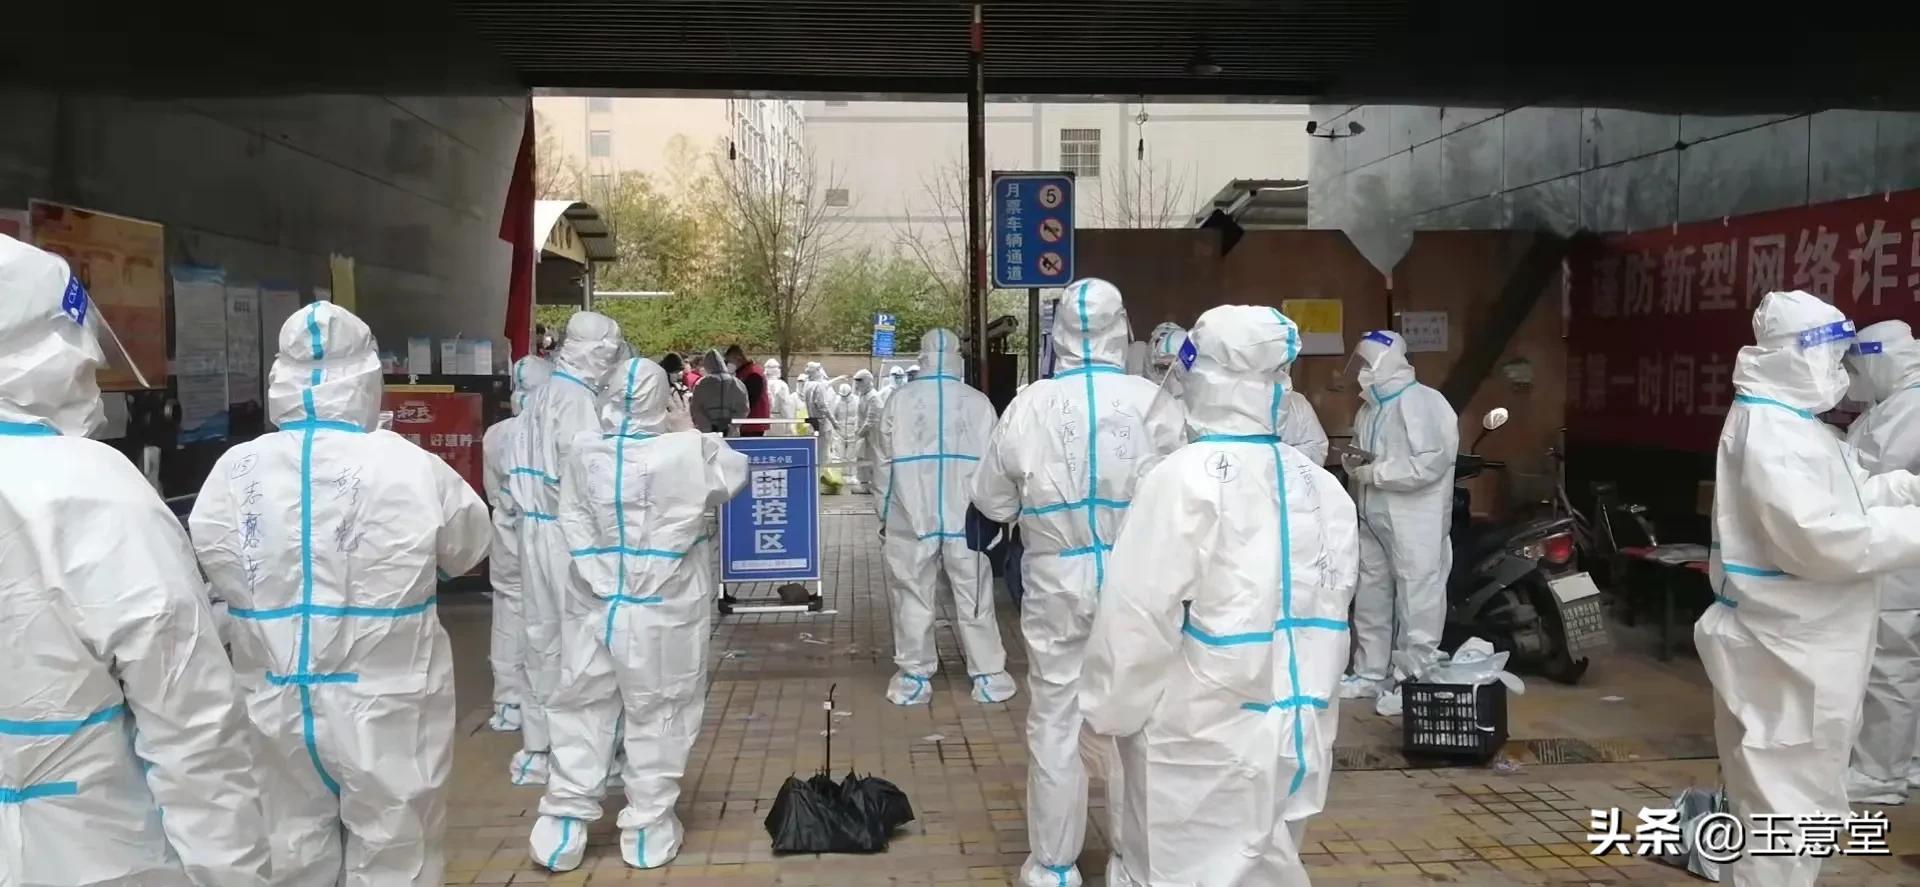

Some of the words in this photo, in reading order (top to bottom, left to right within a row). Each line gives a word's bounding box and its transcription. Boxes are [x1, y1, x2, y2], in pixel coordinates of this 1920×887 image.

[1046, 188, 1057, 204] 5
[1006, 183, 1022, 281] 月票车辆通道
[748, 455, 793, 465] 光上东小区
[1215, 453, 1232, 480] 4
[752, 469, 789, 554] 封控区
